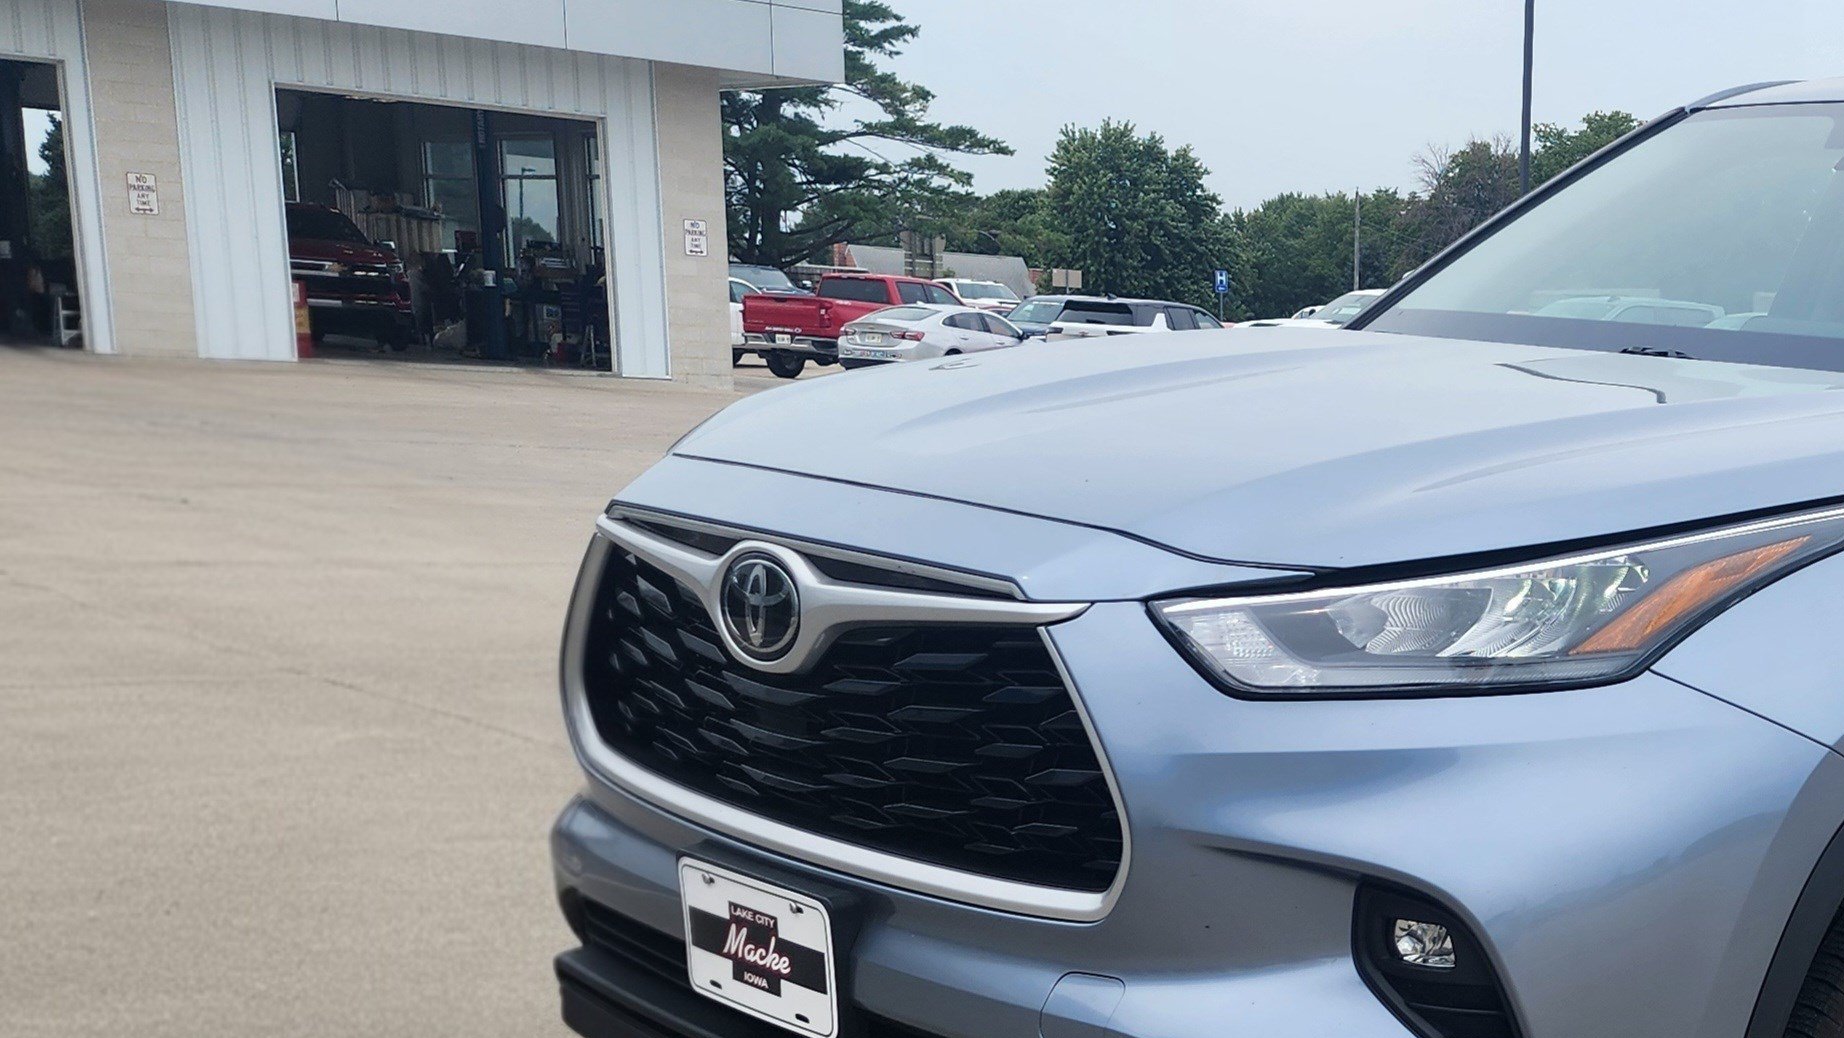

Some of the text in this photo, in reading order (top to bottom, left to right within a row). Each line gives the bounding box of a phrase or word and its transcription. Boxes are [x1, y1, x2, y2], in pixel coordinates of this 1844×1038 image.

[135, 174, 147, 184] NO
[1217, 271, 1226, 285] H
[730, 905, 775, 928] LAKE CITY
[722, 922, 792, 975] Macke
[743, 971, 770, 990] IOWA
